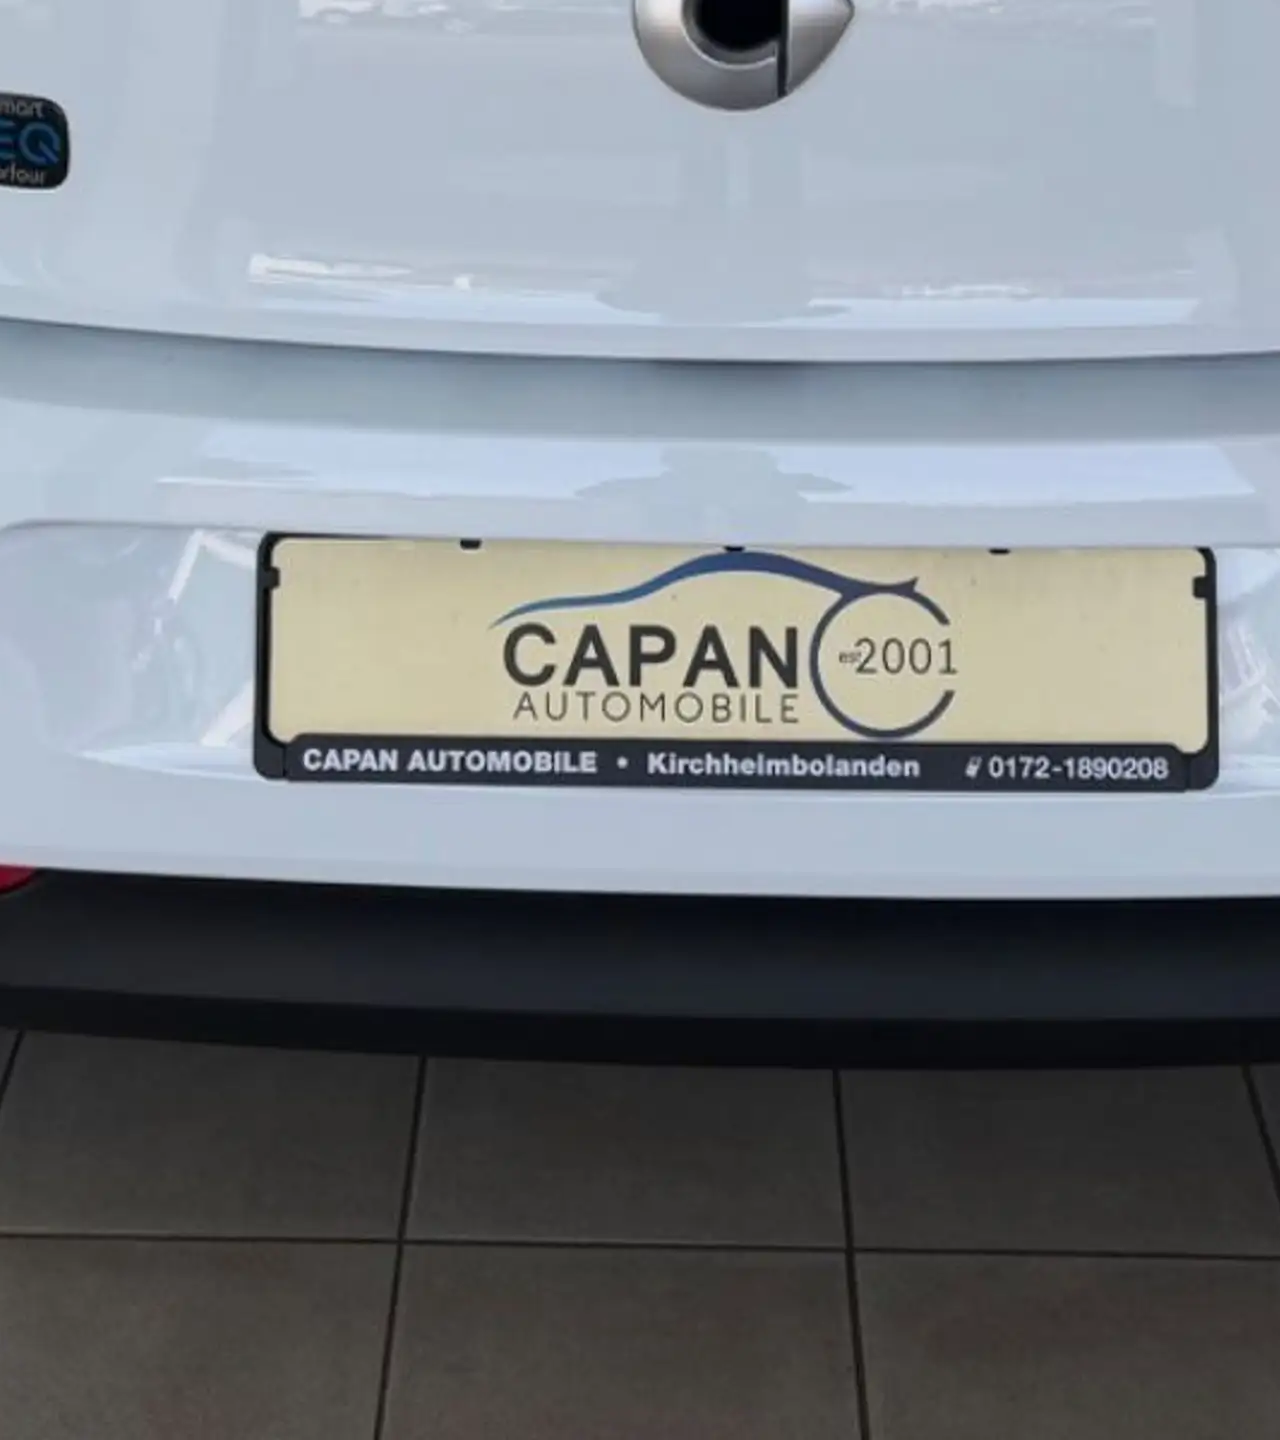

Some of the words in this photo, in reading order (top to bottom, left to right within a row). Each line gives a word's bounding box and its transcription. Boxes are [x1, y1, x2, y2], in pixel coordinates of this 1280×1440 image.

[503, 623, 799, 689] CAPAN
[853, 637, 958, 675] 2001
[512, 692, 800, 724] AUTOMOBILE
[303, 749, 399, 772] CAPAN
[407, 750, 598, 774] AUTOMOBILE
[647, 753, 920, 778] Kirchheimbolanden
[989, 757, 1169, 779] 0172-1890208
